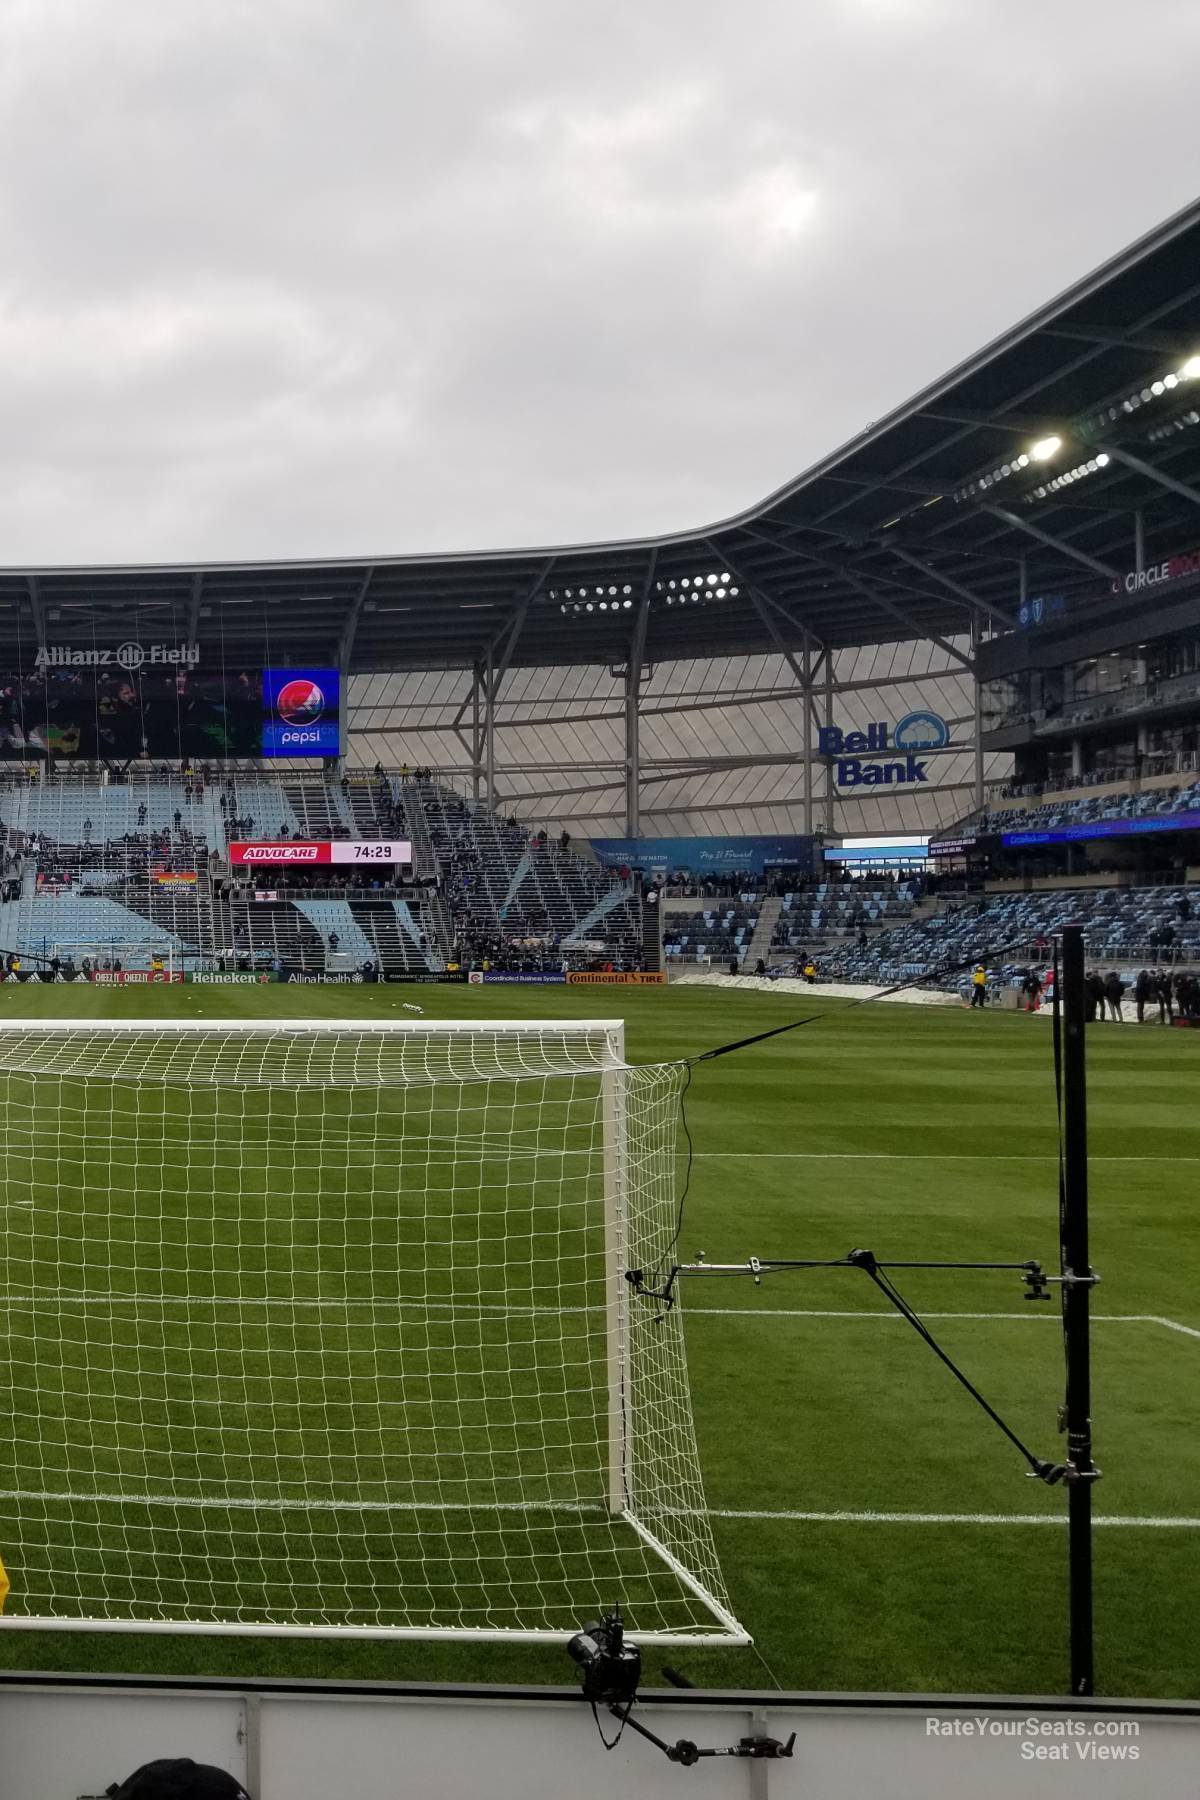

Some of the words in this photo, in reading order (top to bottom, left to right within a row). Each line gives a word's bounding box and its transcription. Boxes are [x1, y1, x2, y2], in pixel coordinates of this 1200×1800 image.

[1125, 562, 1170, 593] CIRCLE
[34, 646, 112, 666] Allianz
[150, 643, 200, 664] Field
[281, 730, 320, 745] pepsi
[818, 722, 888, 754] Bell
[838, 755, 928, 787] Bank
[243, 847, 318, 860] ADVOCARE
[354, 846, 392, 858] 74:29
[191, 972, 257, 984] Heineken
[519, 975, 542, 983] Business
[569, 972, 628, 984] Continental
[640, 975, 663, 983] TIRE
